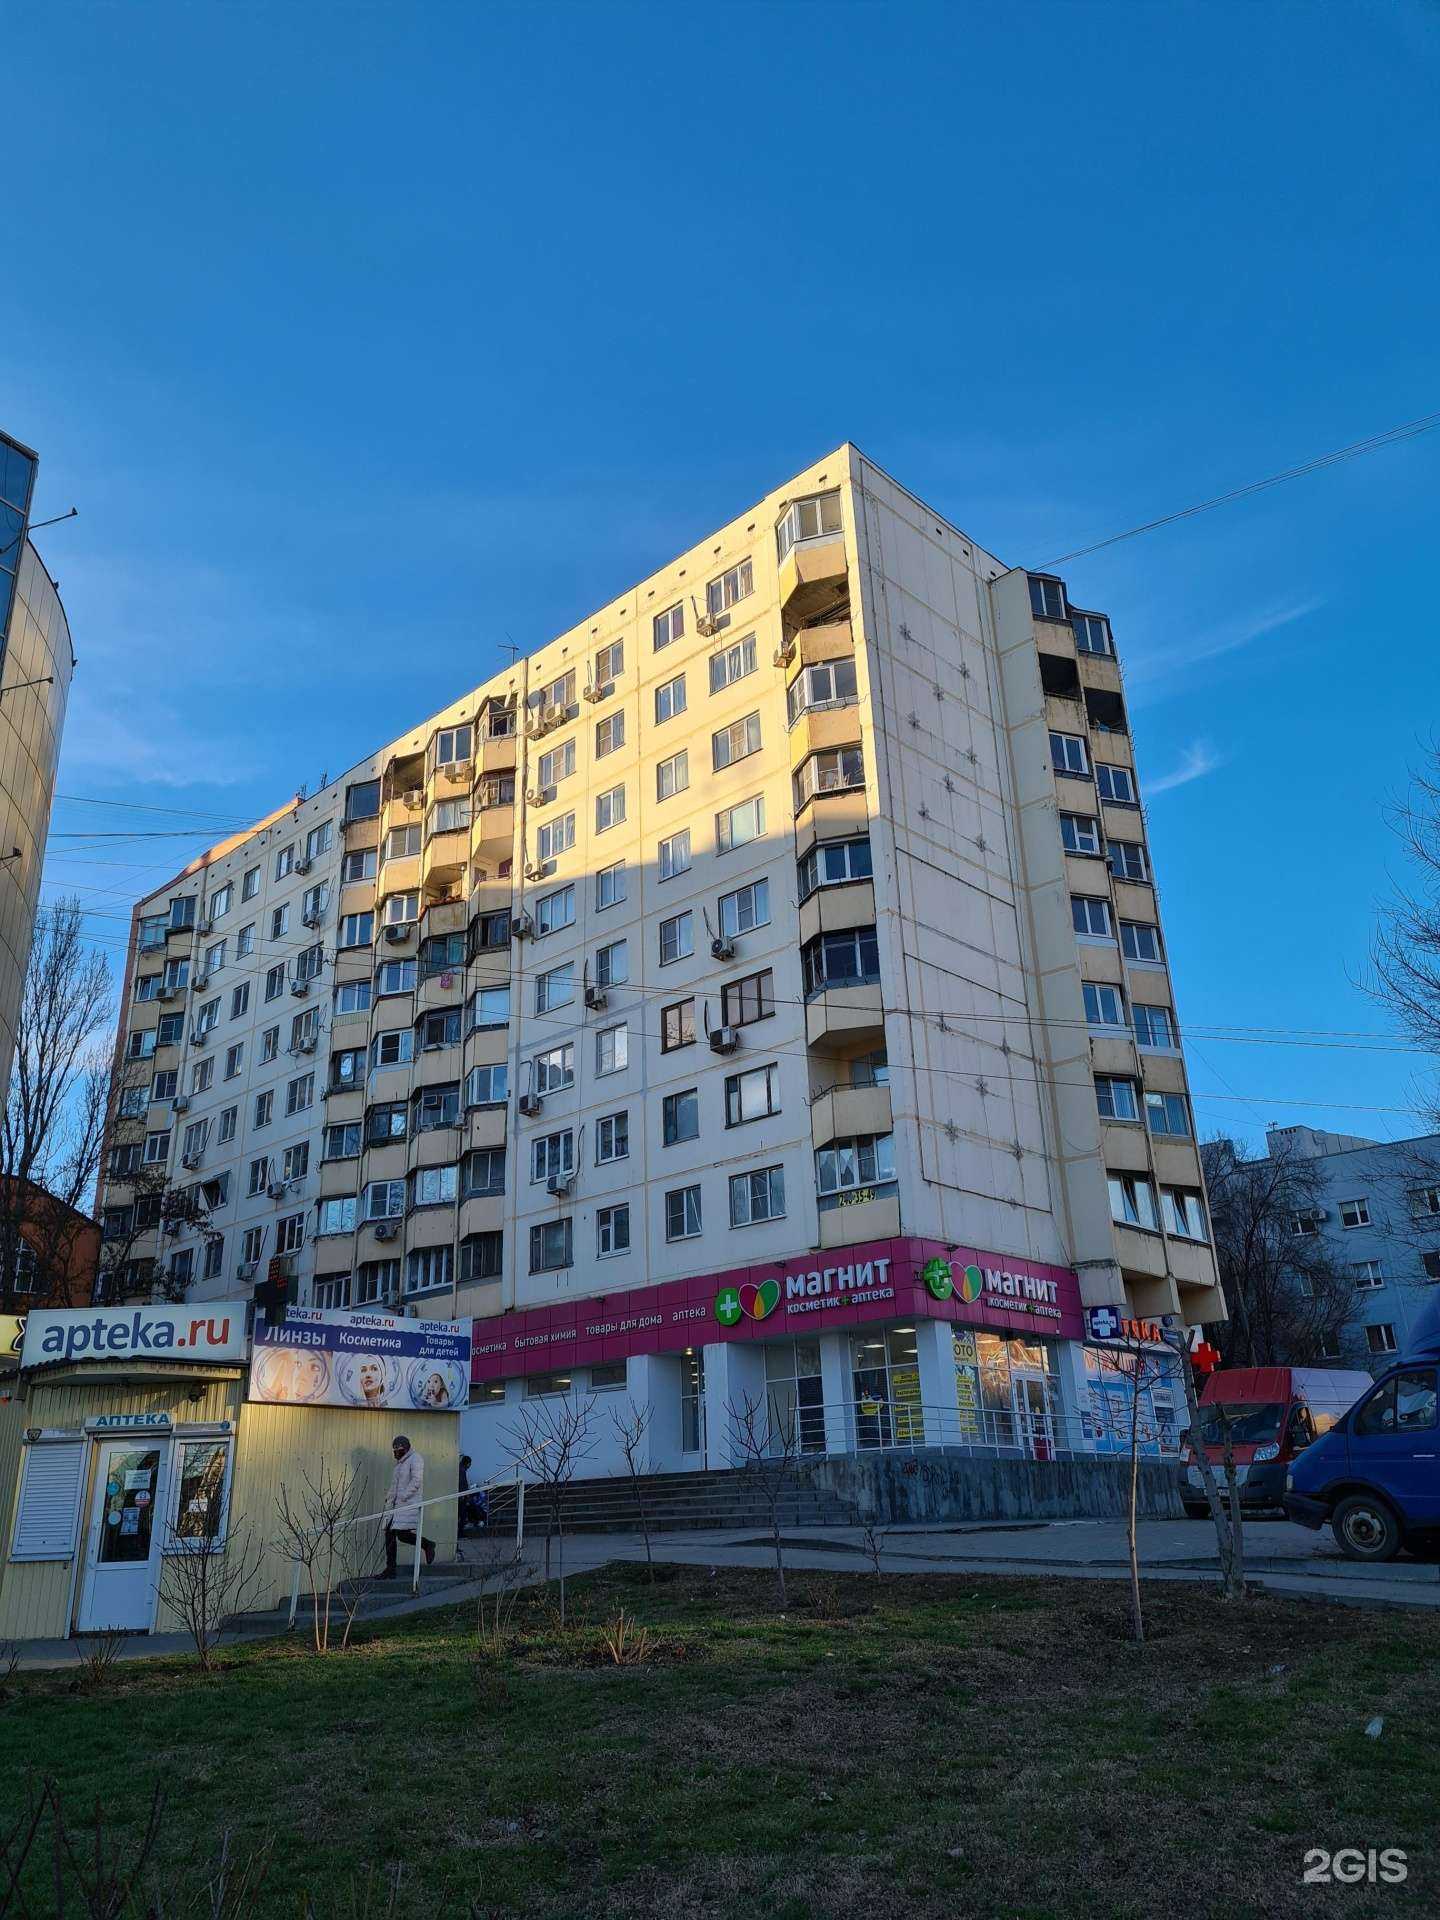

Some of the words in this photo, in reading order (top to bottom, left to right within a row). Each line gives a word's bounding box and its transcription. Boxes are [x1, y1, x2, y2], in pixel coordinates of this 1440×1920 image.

[286, 1307, 323, 1321] teka.ru
[672, 1306, 706, 1321] аптека
[350, 1314, 395, 1328] apteka.ru
[419, 1320, 460, 1334] apteka.ru
[585, 1322, 618, 1336] товары
[619, 1318, 637, 1332] для
[638, 1313, 663, 1329] дома
[42, 1312, 230, 1359] apteka.ru
[264, 1326, 326, 1346] Линзы
[339, 1331, 402, 1349] Косметика
[426, 1334, 454, 1346] Товары
[514, 1334, 548, 1349] бытовая
[549, 1329, 577, 1343] химия
[419, 1346, 434, 1356] для
[435, 1347, 459, 1357] детей
[471, 1342, 507, 1356] осметика
[96, 1413, 169, 1427] АПТЕКА
